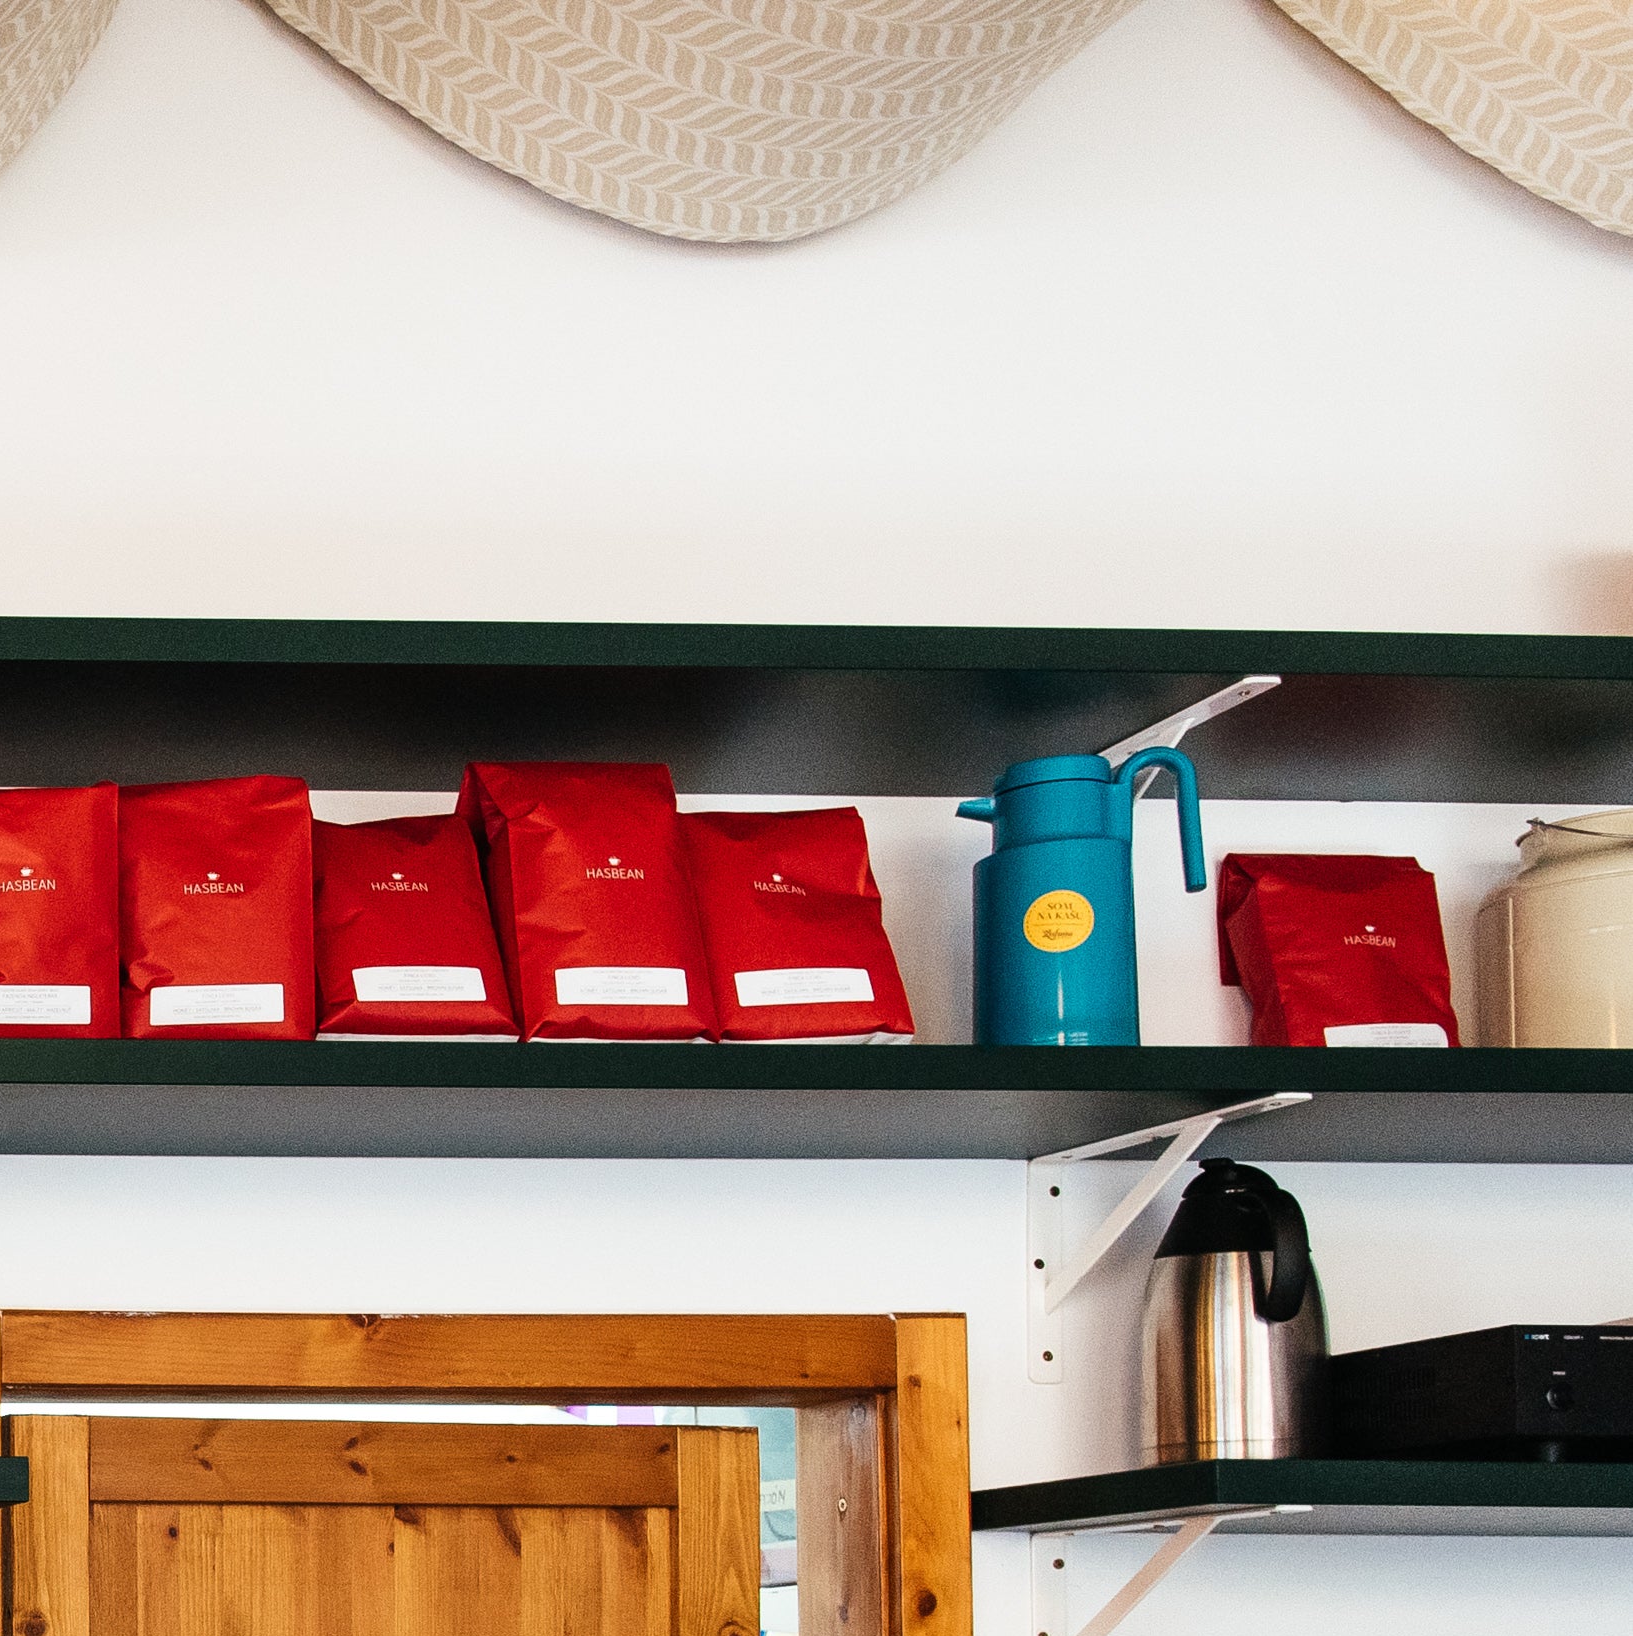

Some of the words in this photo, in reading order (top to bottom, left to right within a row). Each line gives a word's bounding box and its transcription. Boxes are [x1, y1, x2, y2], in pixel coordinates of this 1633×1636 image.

[585, 867, 645, 880] HASBEAN
[183, 882, 244, 895] HASBEAN
[371, 881, 428, 893] HASBEAN
[753, 880, 807, 897] HASBEAN
[1047, 902, 1073, 910] SOM
[1343, 934, 1396, 948] HASBEAN
